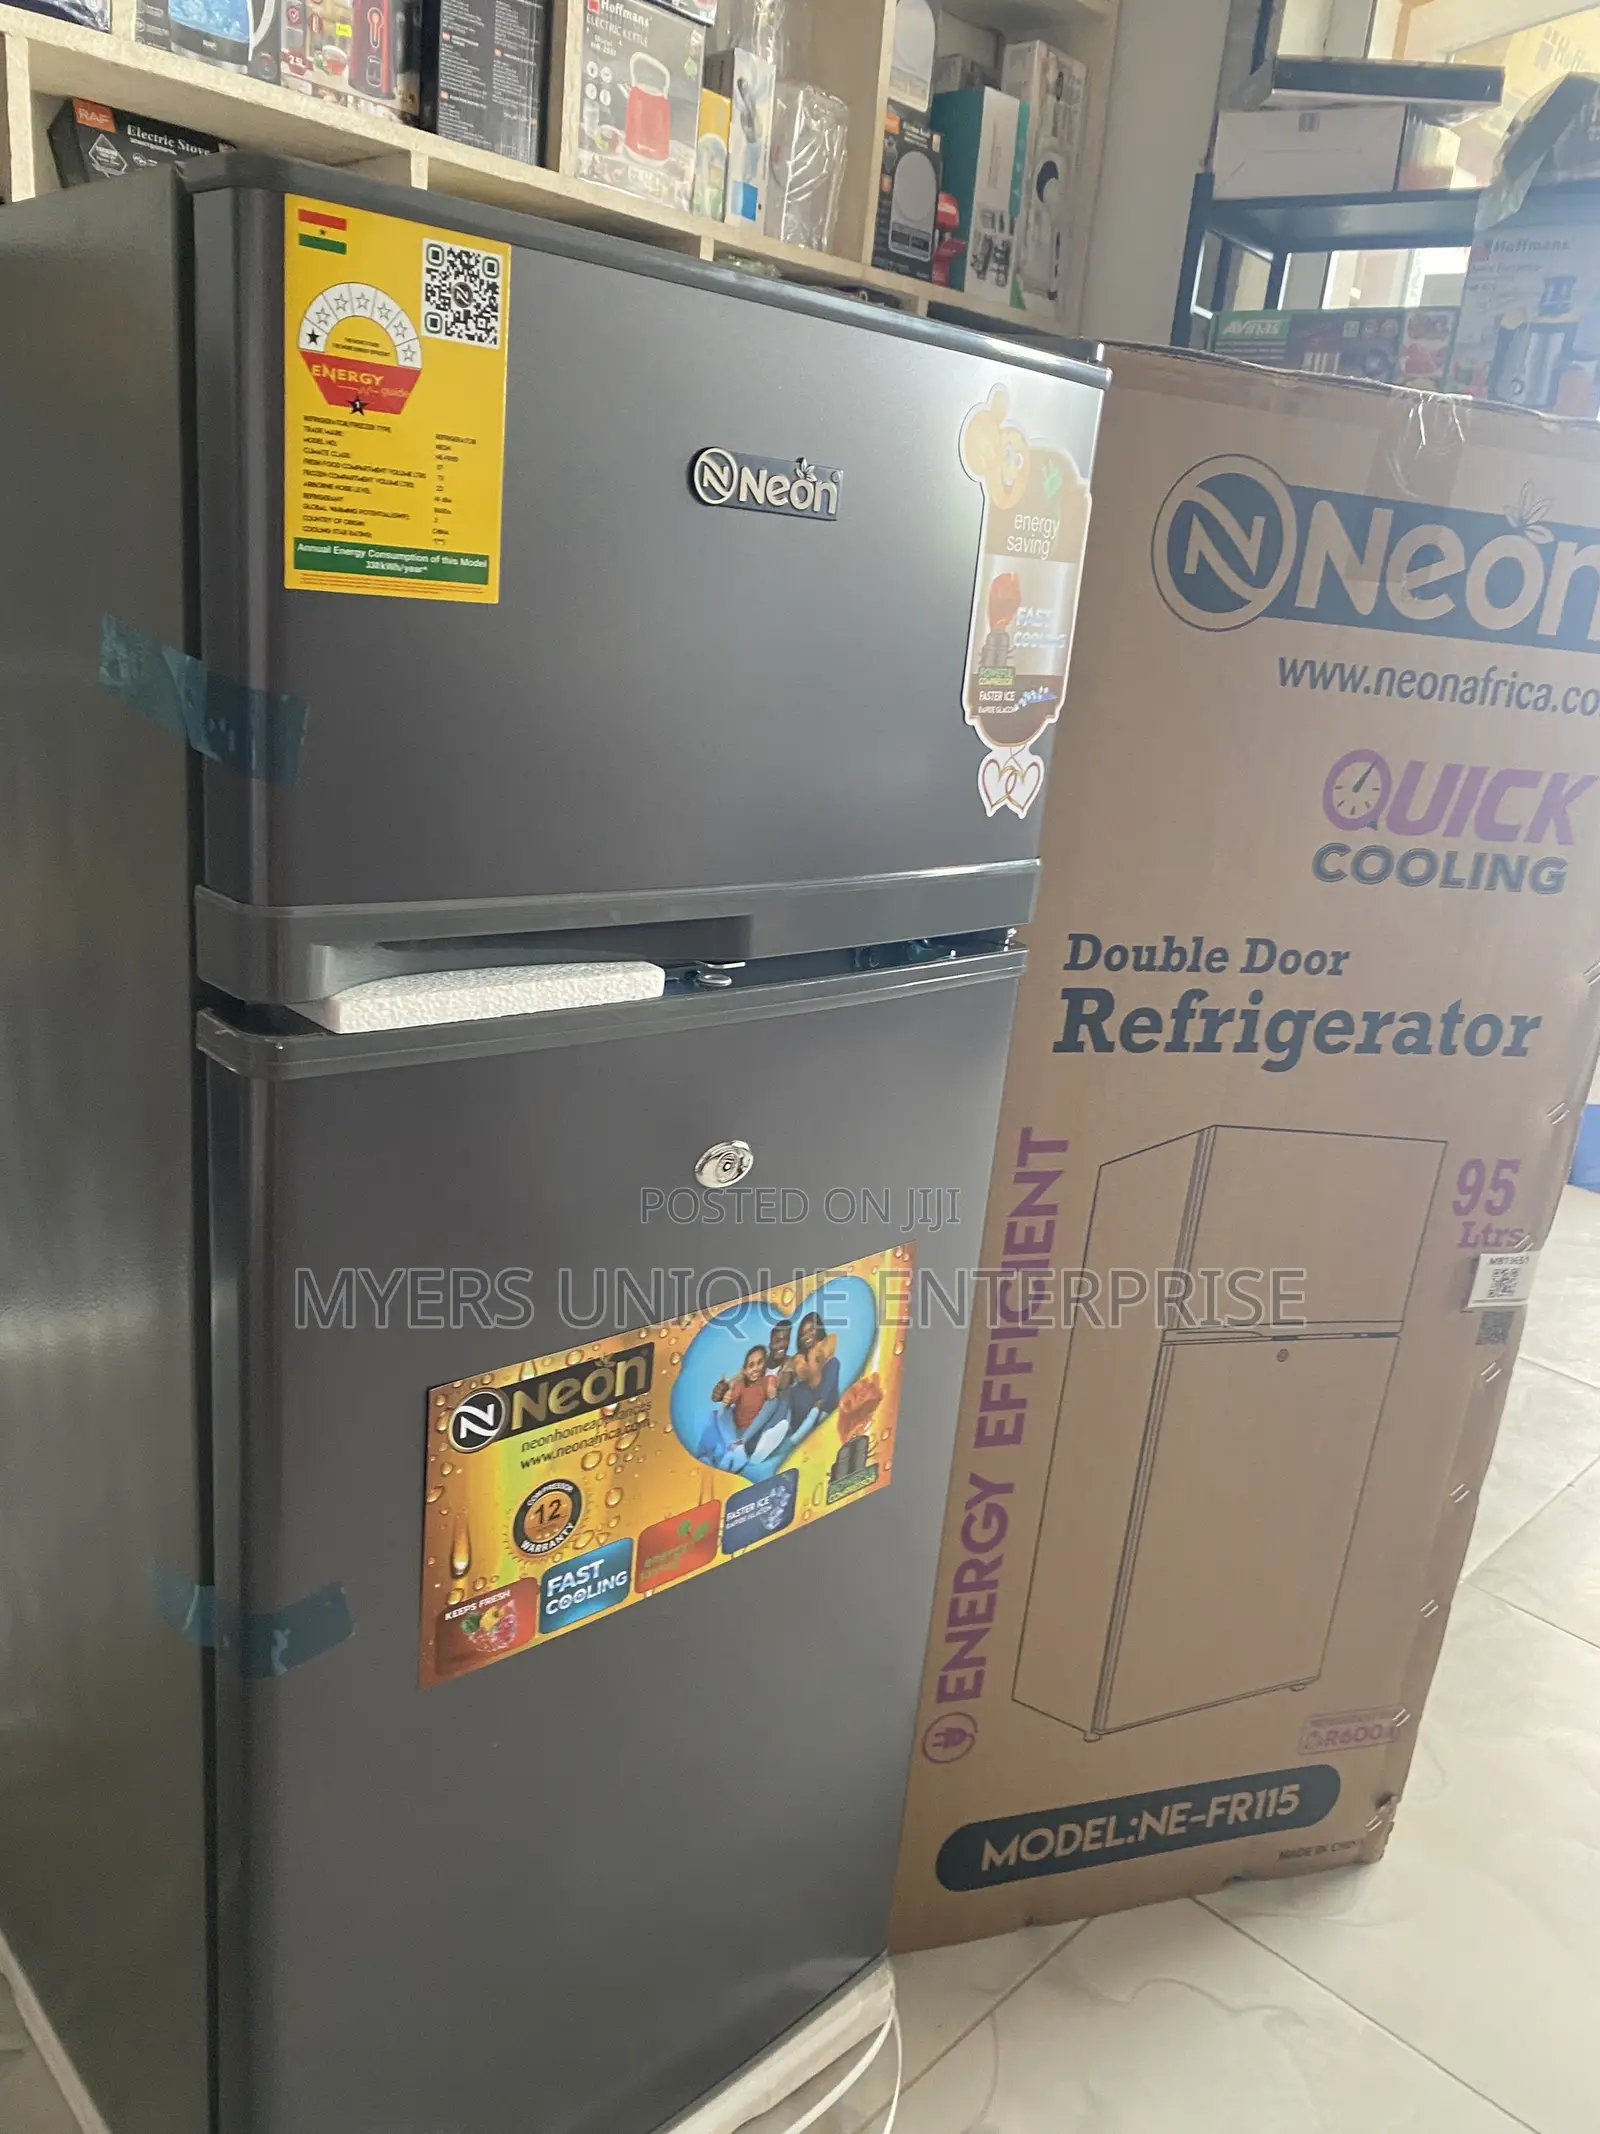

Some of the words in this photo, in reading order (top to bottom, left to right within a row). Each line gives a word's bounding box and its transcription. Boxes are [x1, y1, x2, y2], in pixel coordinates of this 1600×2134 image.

[586, 13, 622, 36] ELECTRIC
[78, 107, 110, 124] RAF
[127, 123, 176, 149] Electric
[312, 363, 385, 385] ENERGY
[739, 465, 838, 515] Neon
[1014, 513, 1060, 539] energy
[297, 543, 332, 554] Annual
[333, 546, 367, 559] Energy
[368, 549, 429, 563] Consumption
[430, 554, 440, 564] of
[441, 556, 459, 566] this
[460, 557, 488, 569] Model
[1007, 534, 1051, 560] saving
[978, 690, 1003, 702] FASTER
[1003, 690, 1017, 701] ICE
[1277, 656, 1600, 717] www.neonafrica.co
[1322, 748, 1600, 847] QUICK
[1312, 842, 1569, 896] COOLING
[1063, 932, 1230, 975] Double
[1239, 936, 1351, 977] Door
[1052, 987, 1542, 1073] Refrigerator
[1452, 1157, 1521, 1217] 95
[1459, 1220, 1526, 1249] Ltrs
[973, 1126, 1071, 1452] EFFICIENT
[511, 1356, 647, 1431] Neon
[535, 1498, 563, 1525] 12
[726, 1500, 756, 1523] FASTER
[756, 1495, 771, 1509] ICE
[520, 1522, 575, 1553] WARRANTY
[545, 1570, 628, 1616] COOLING
[547, 1558, 605, 1598] FAST
[935, 1471, 1016, 1705] ENERGY
[444, 1599, 478, 1622] KEEPS
[478, 1589, 512, 1609] FRESH
[981, 1782, 1301, 1873] MODEL:NE-FR115
